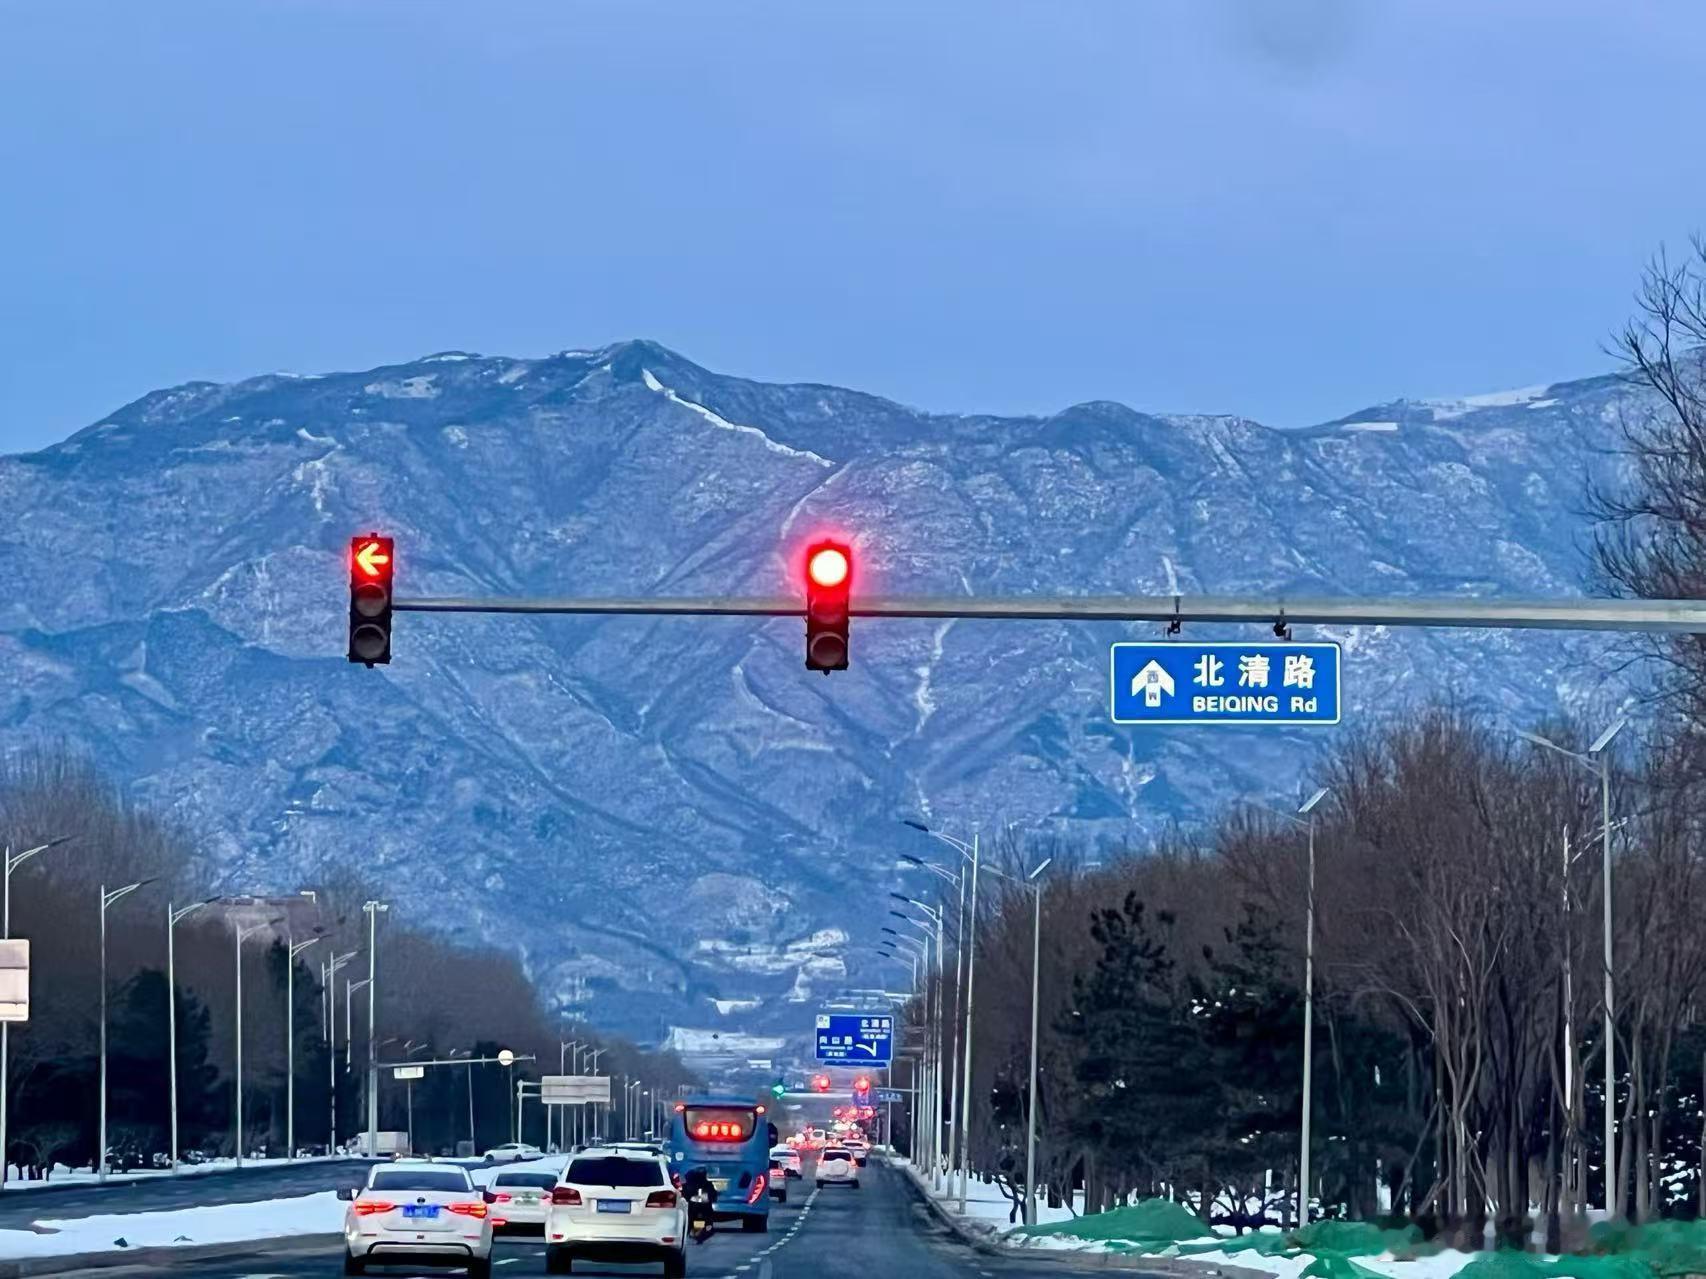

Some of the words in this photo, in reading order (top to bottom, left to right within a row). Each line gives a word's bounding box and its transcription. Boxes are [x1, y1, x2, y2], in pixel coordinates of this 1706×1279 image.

[1193, 654, 1316, 688] 北清路
[1193, 696, 1279, 712] BEIQING
[1291, 697, 1317, 712] Rd
